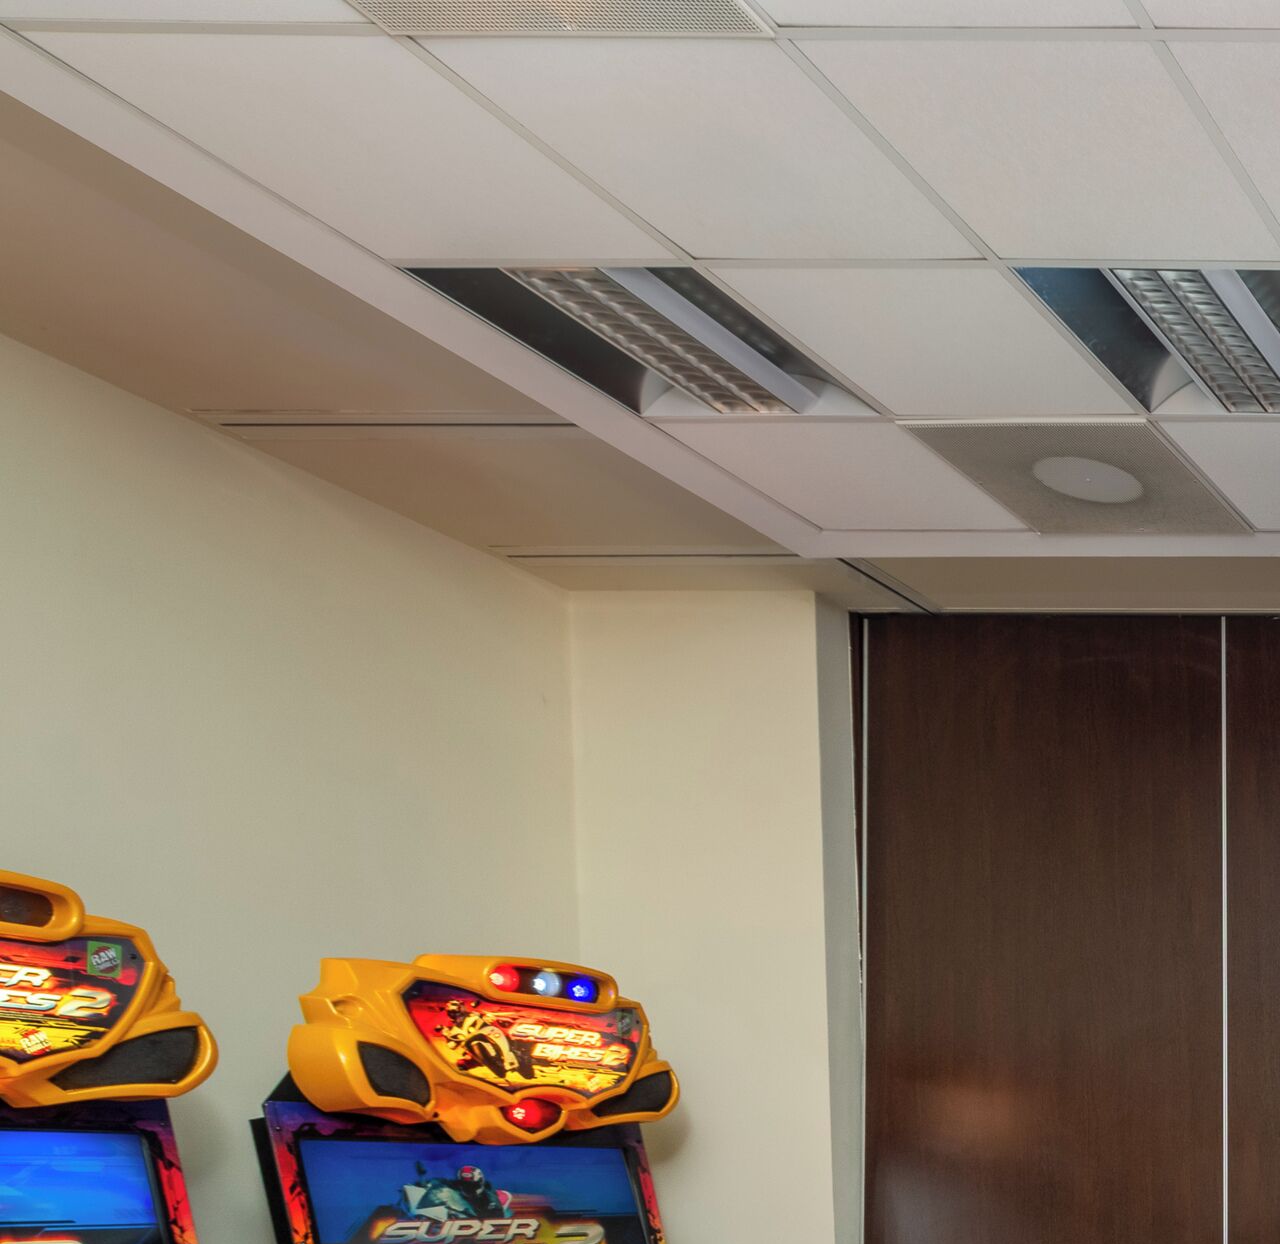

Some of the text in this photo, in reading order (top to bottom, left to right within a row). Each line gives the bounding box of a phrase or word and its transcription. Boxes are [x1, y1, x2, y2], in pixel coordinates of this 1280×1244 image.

[57, 987, 112, 1018] 2
[513, 1024, 602, 1047] SUPER
[533, 1042, 630, 1066] BIKES 2
